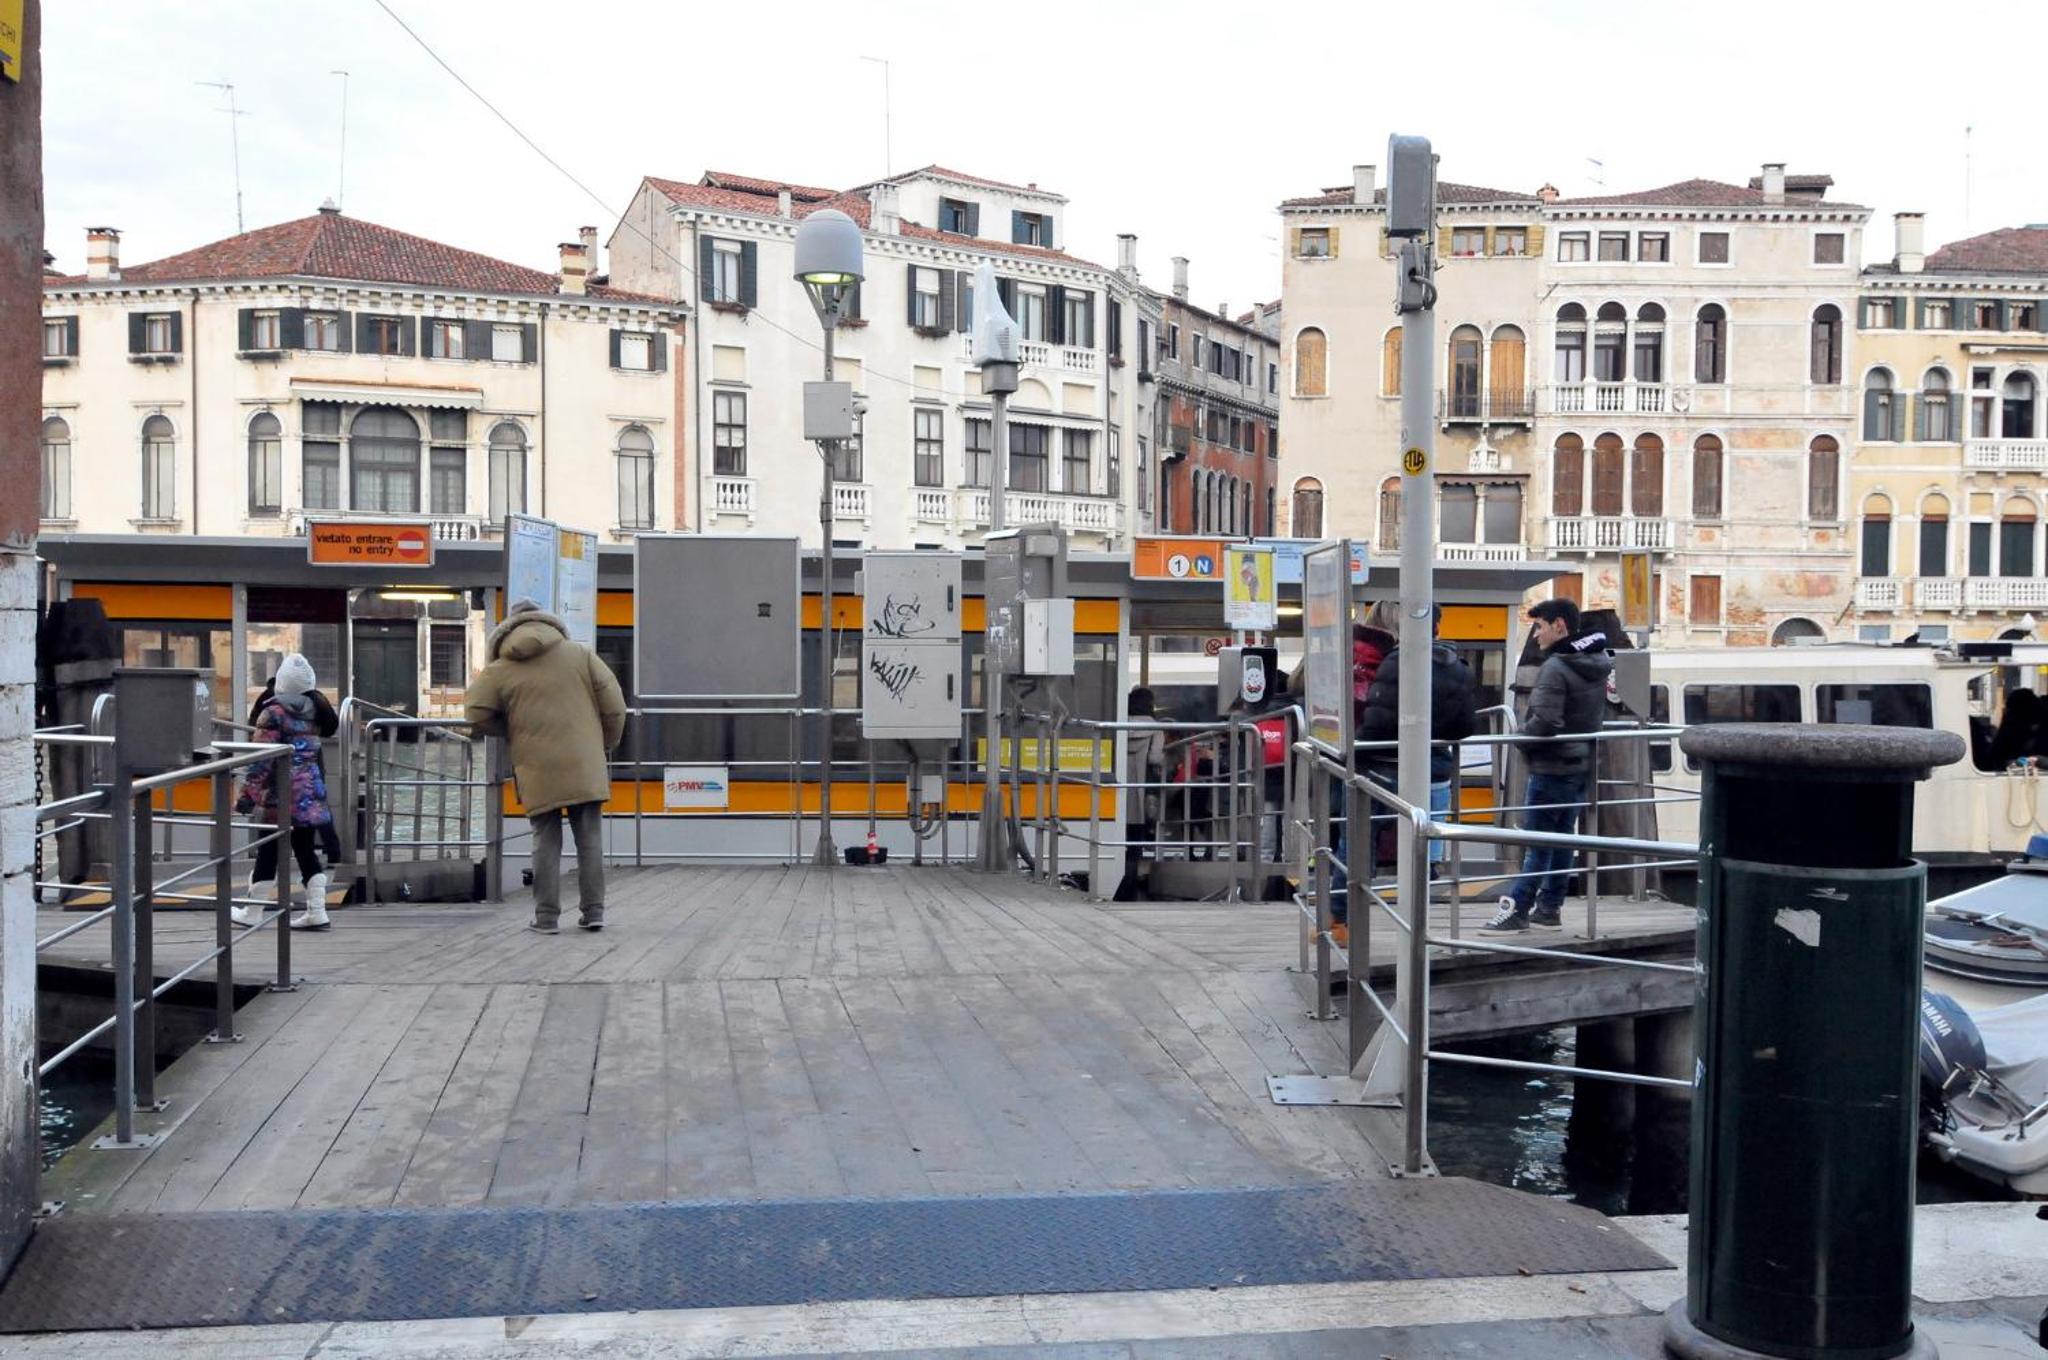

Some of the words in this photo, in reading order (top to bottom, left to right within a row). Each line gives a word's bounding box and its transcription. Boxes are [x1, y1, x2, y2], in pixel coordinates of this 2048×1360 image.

[316, 533, 352, 544] vietato
[356, 533, 394, 544] entrare
[349, 545, 361, 554] no
[366, 544, 394, 556] entry
[1174, 559, 1182, 573] 1
[1198, 559, 1210, 573] N
[678, 780, 705, 792] PMV
